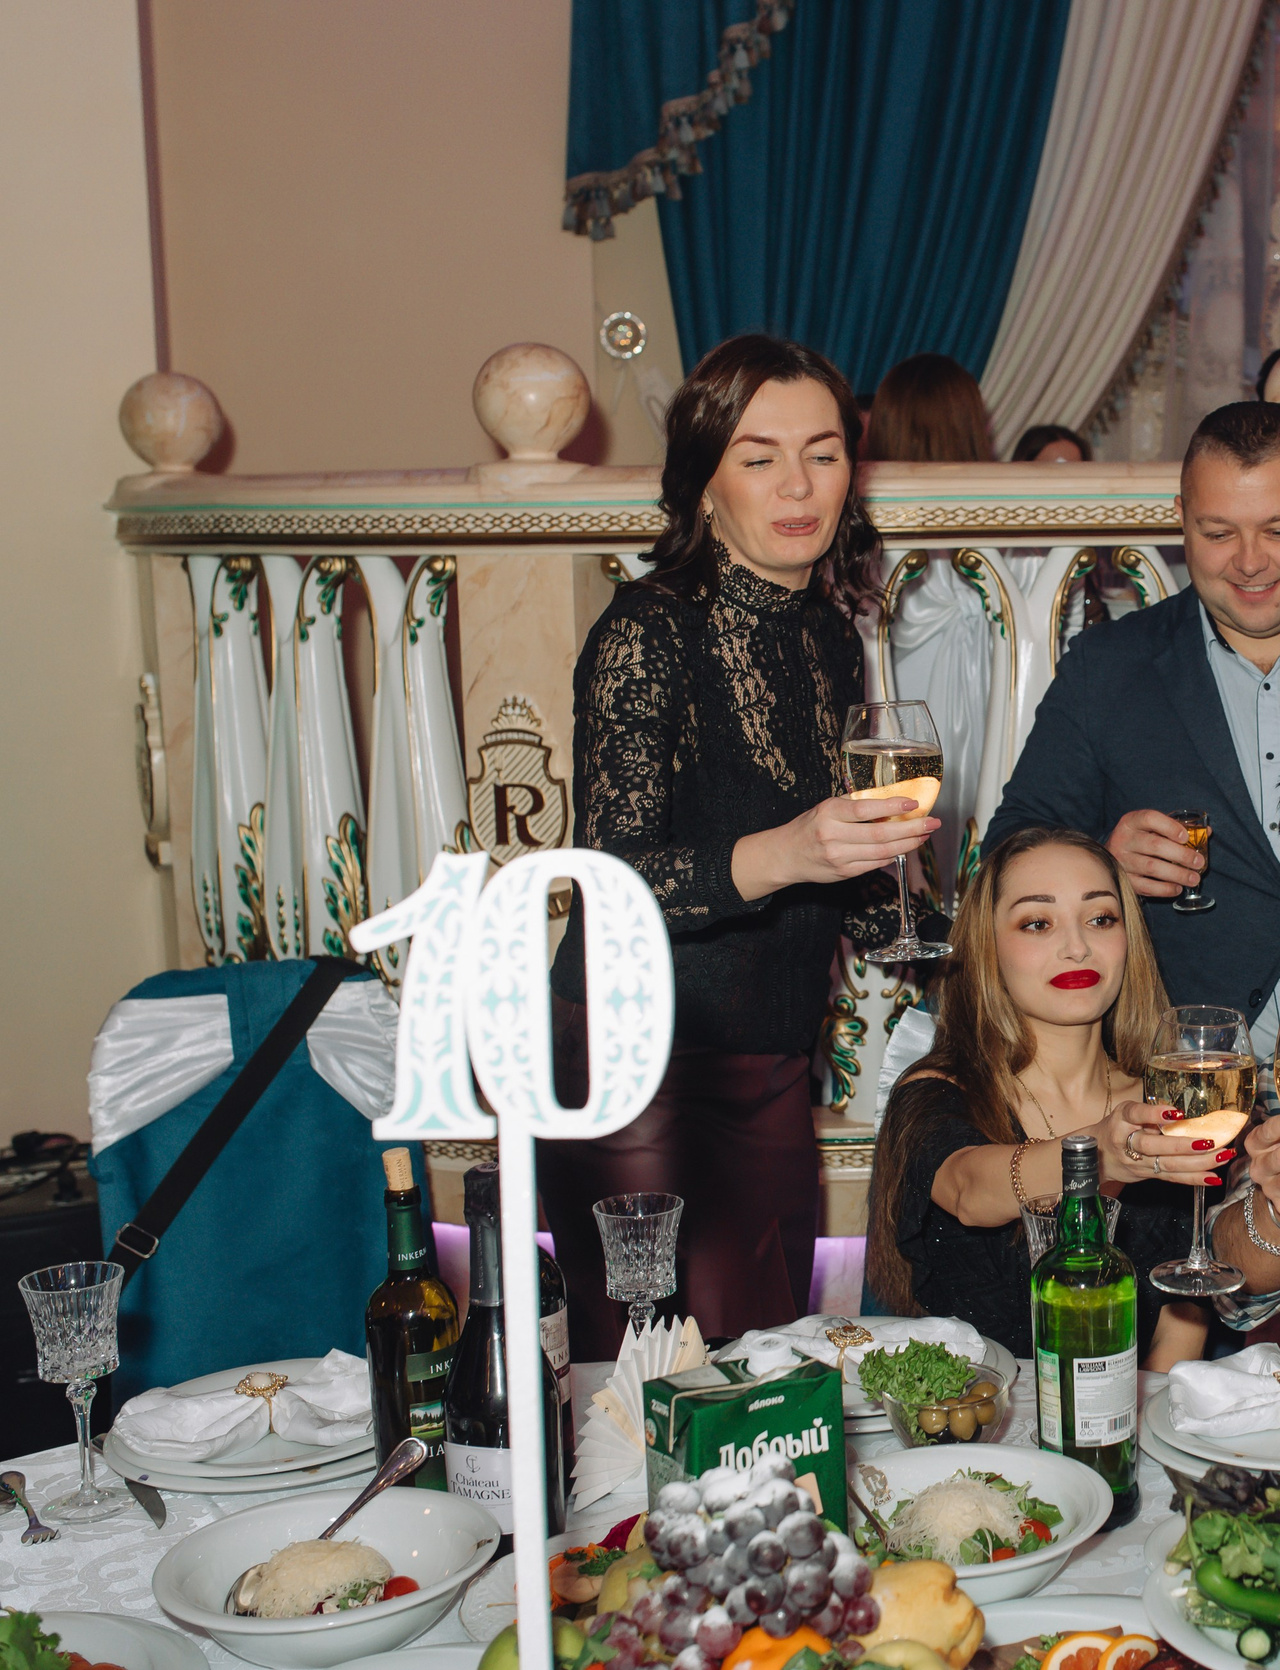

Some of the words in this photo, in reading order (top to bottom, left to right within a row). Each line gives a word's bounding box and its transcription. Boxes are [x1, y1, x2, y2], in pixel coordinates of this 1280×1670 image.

[493, 782, 546, 847] R
[349, 848, 675, 1142] 10
[429, 1358, 454, 1375] INK
[748, 1394, 785, 1413] яблоко
[455, 1472, 499, 1488] Château
[450, 1480, 512, 1500] TAMAGNE
